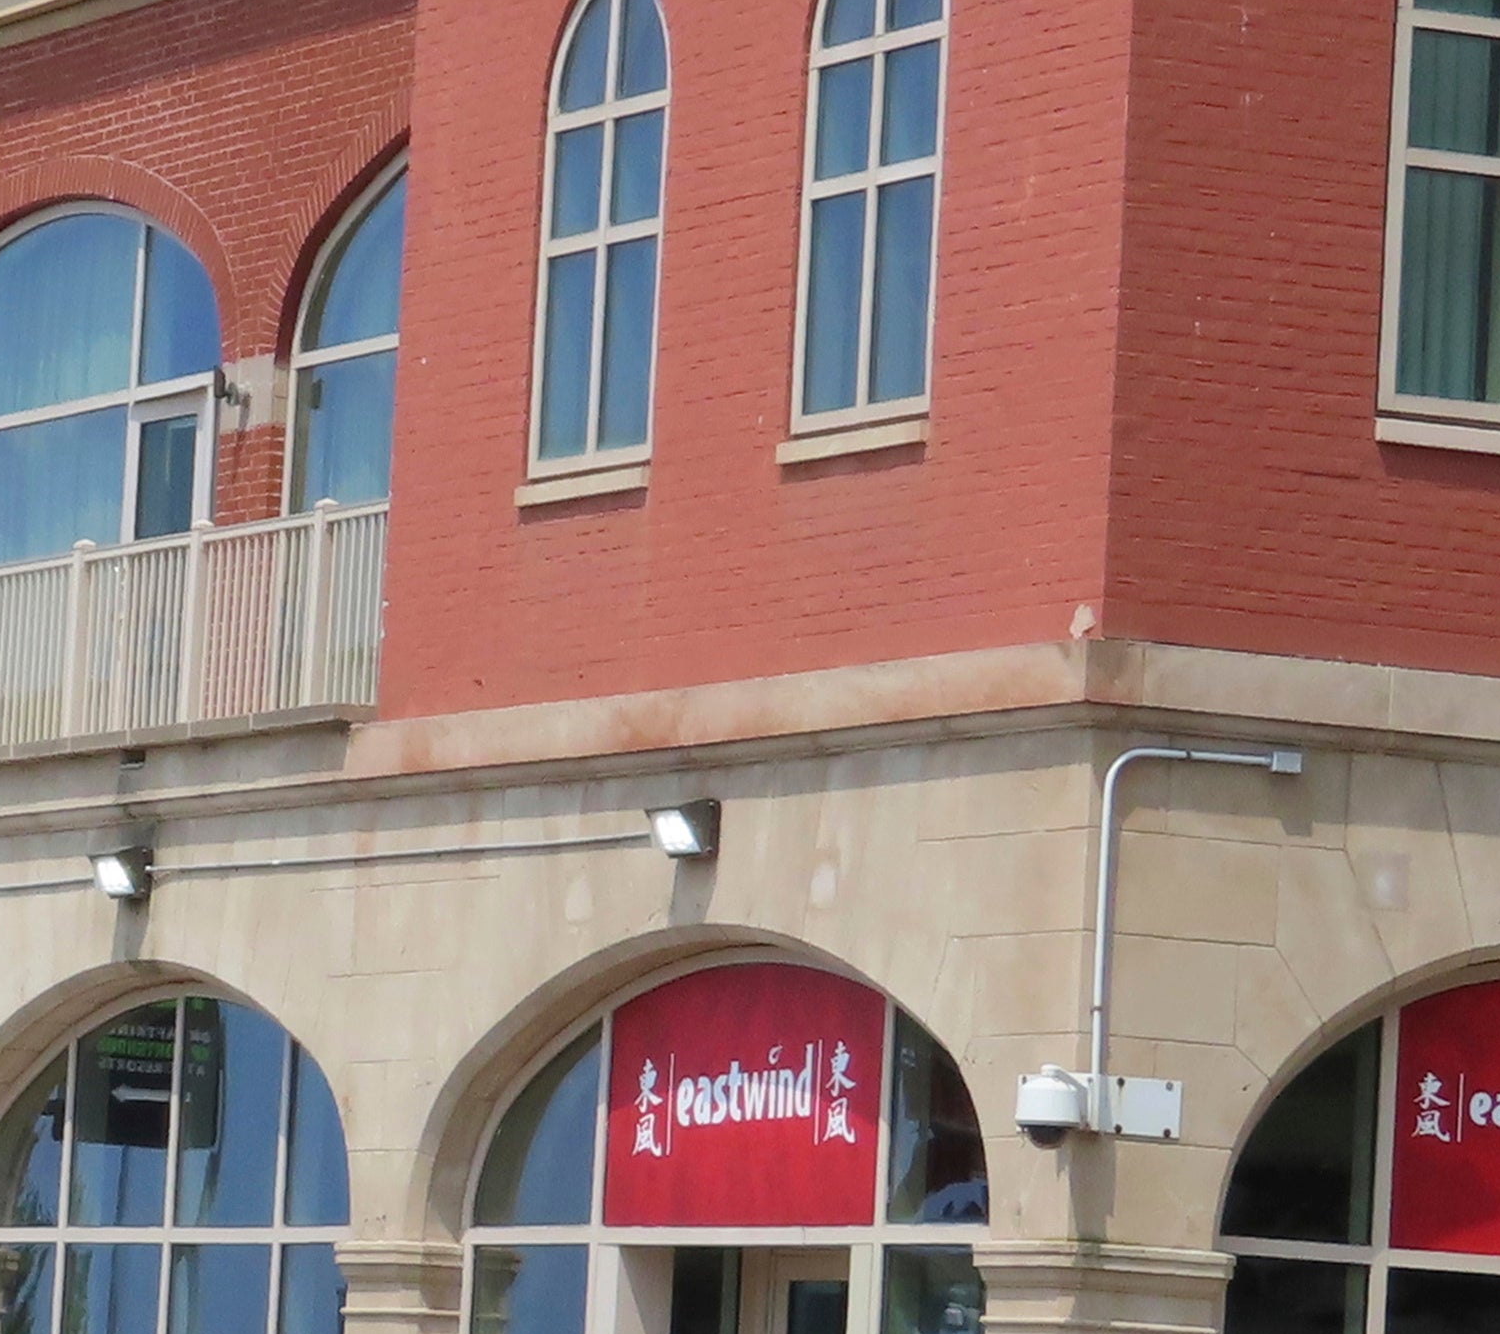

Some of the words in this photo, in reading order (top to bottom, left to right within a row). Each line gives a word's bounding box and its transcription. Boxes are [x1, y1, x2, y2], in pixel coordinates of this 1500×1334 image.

[632, 1058, 663, 1157] 東風
[676, 1043, 813, 1127] eastwind
[822, 1040, 856, 1144] 東風
[1411, 1072, 1451, 1143] 東風
